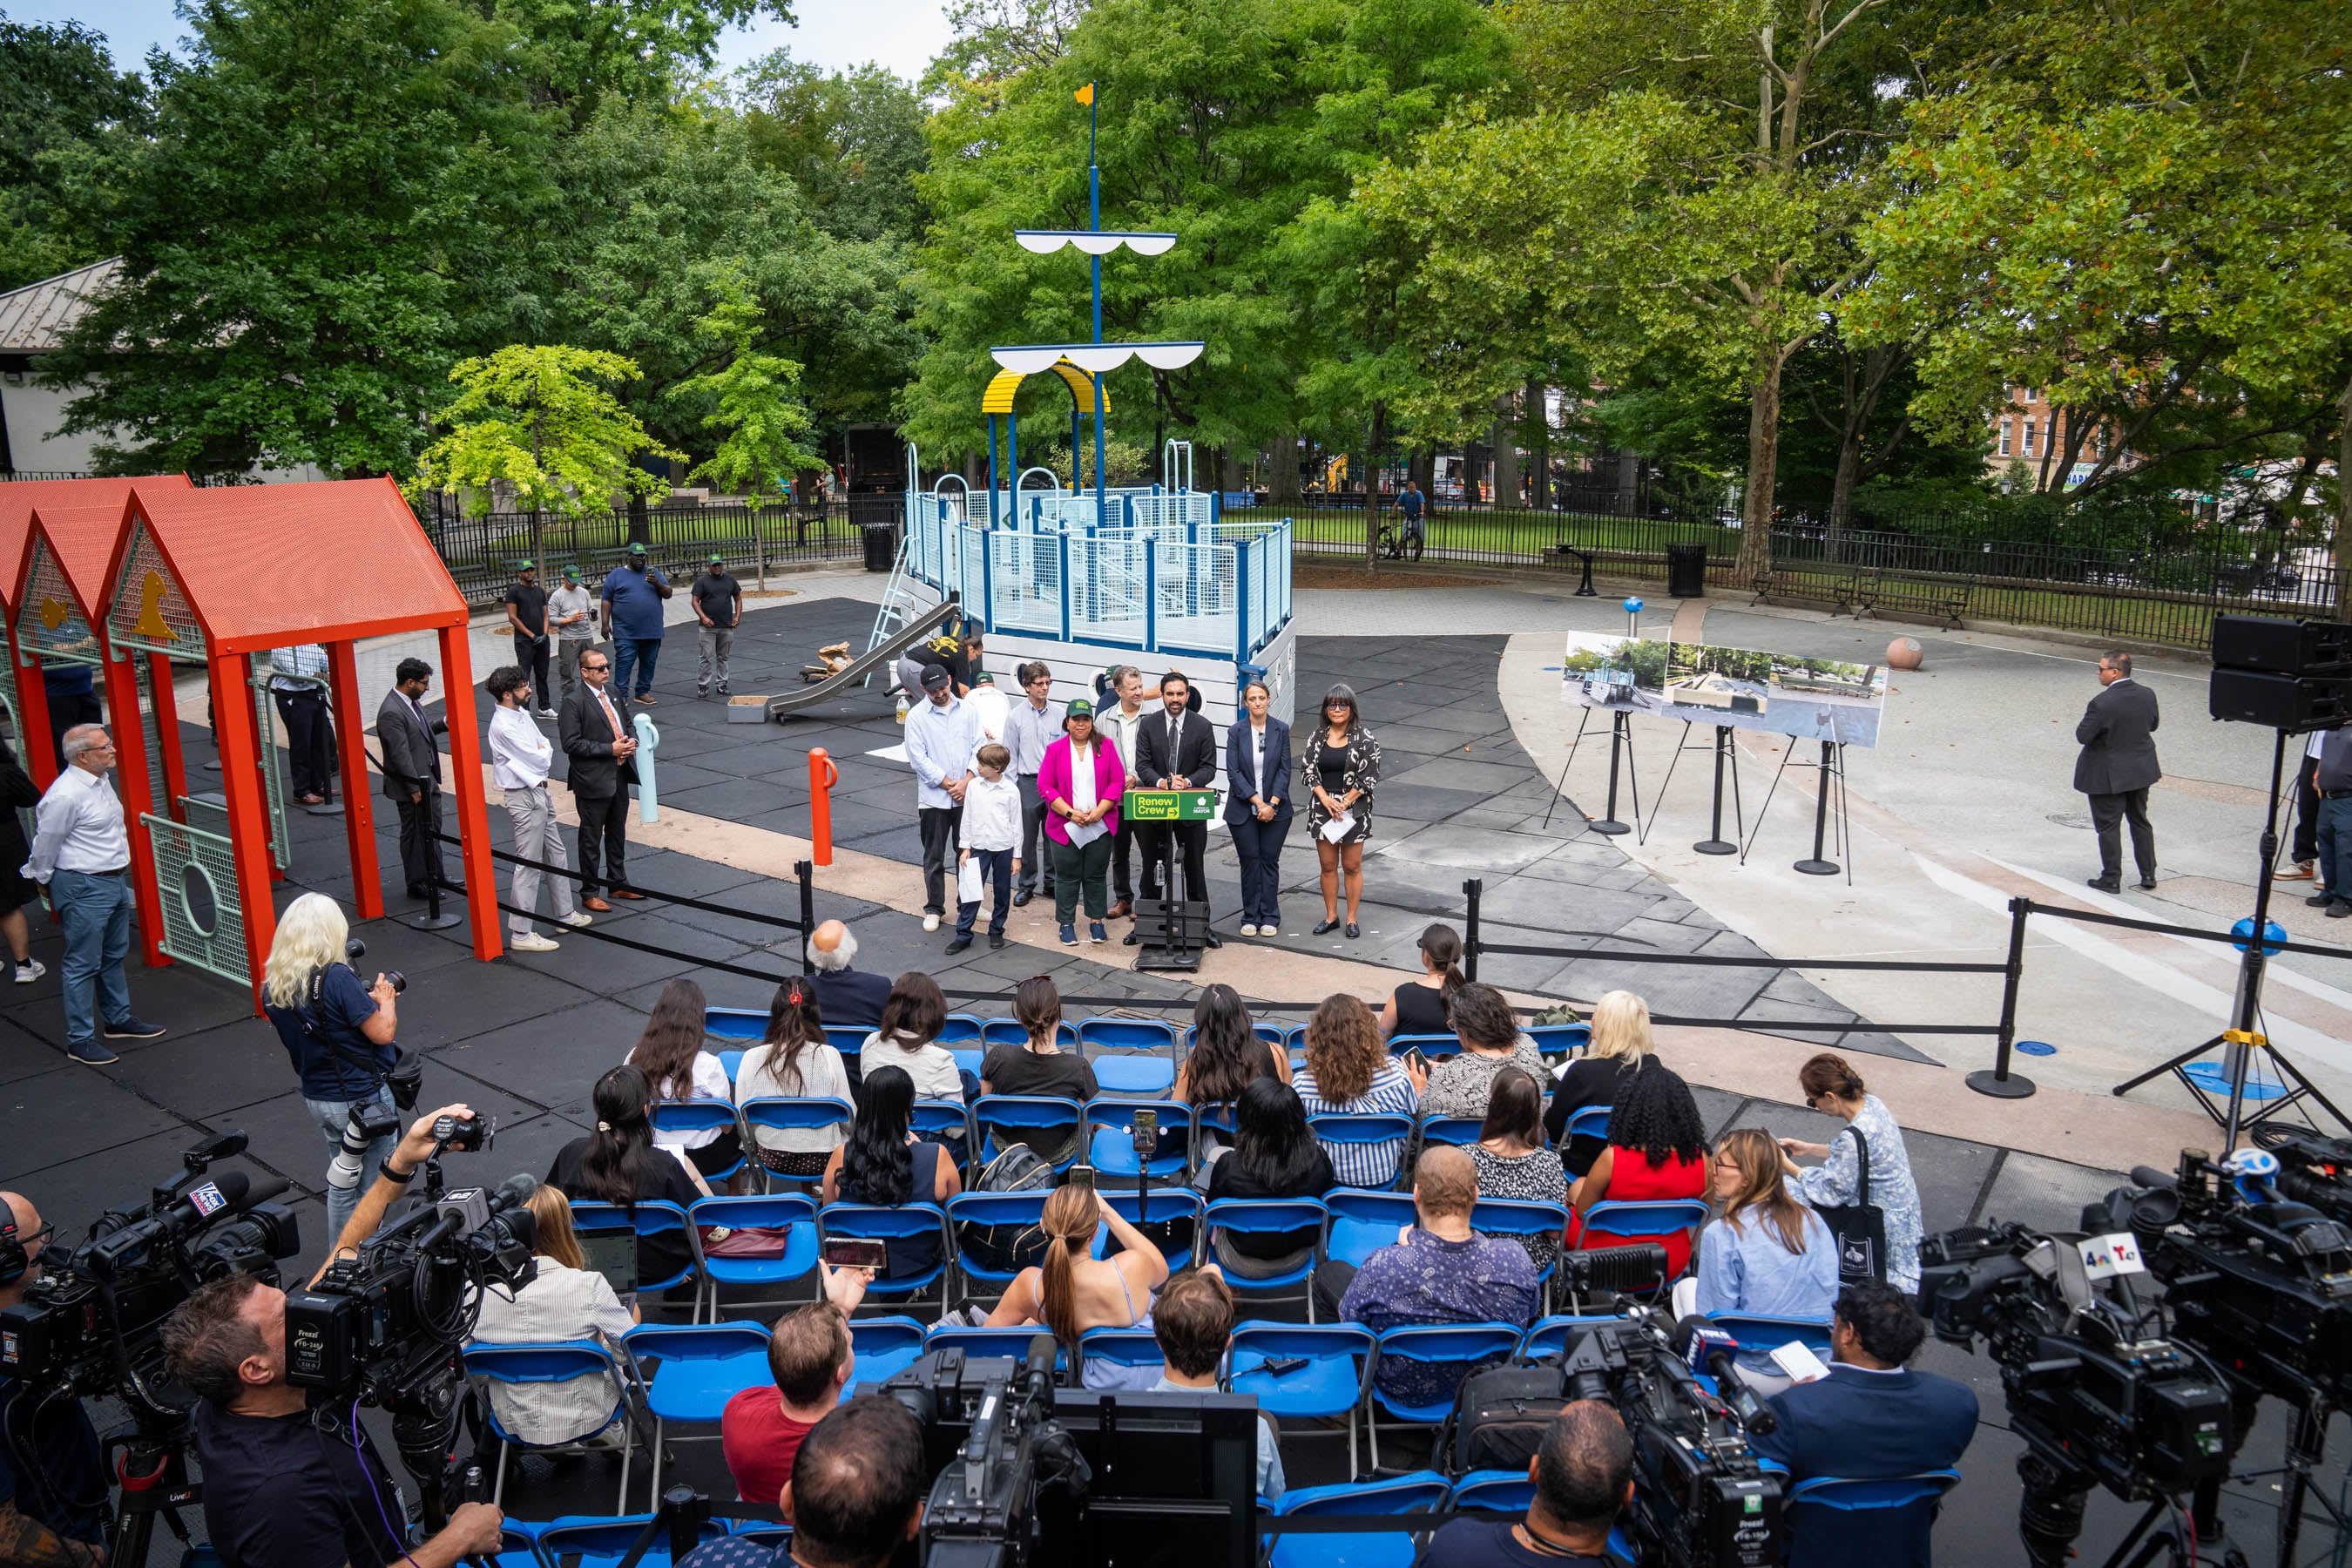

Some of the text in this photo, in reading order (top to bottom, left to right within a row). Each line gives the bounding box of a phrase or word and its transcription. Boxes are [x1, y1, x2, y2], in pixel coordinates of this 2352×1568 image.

[1138, 797, 1173, 806] Renew
[1138, 806, 1165, 814] Crew
[198, 1193, 214, 1211] NEWS
[206, 1193, 220, 1207] FOX
[2086, 1251, 2097, 1267] 4
[298, 1329, 319, 1339] Frezzi
[169, 1490, 191, 1502] LiveU
